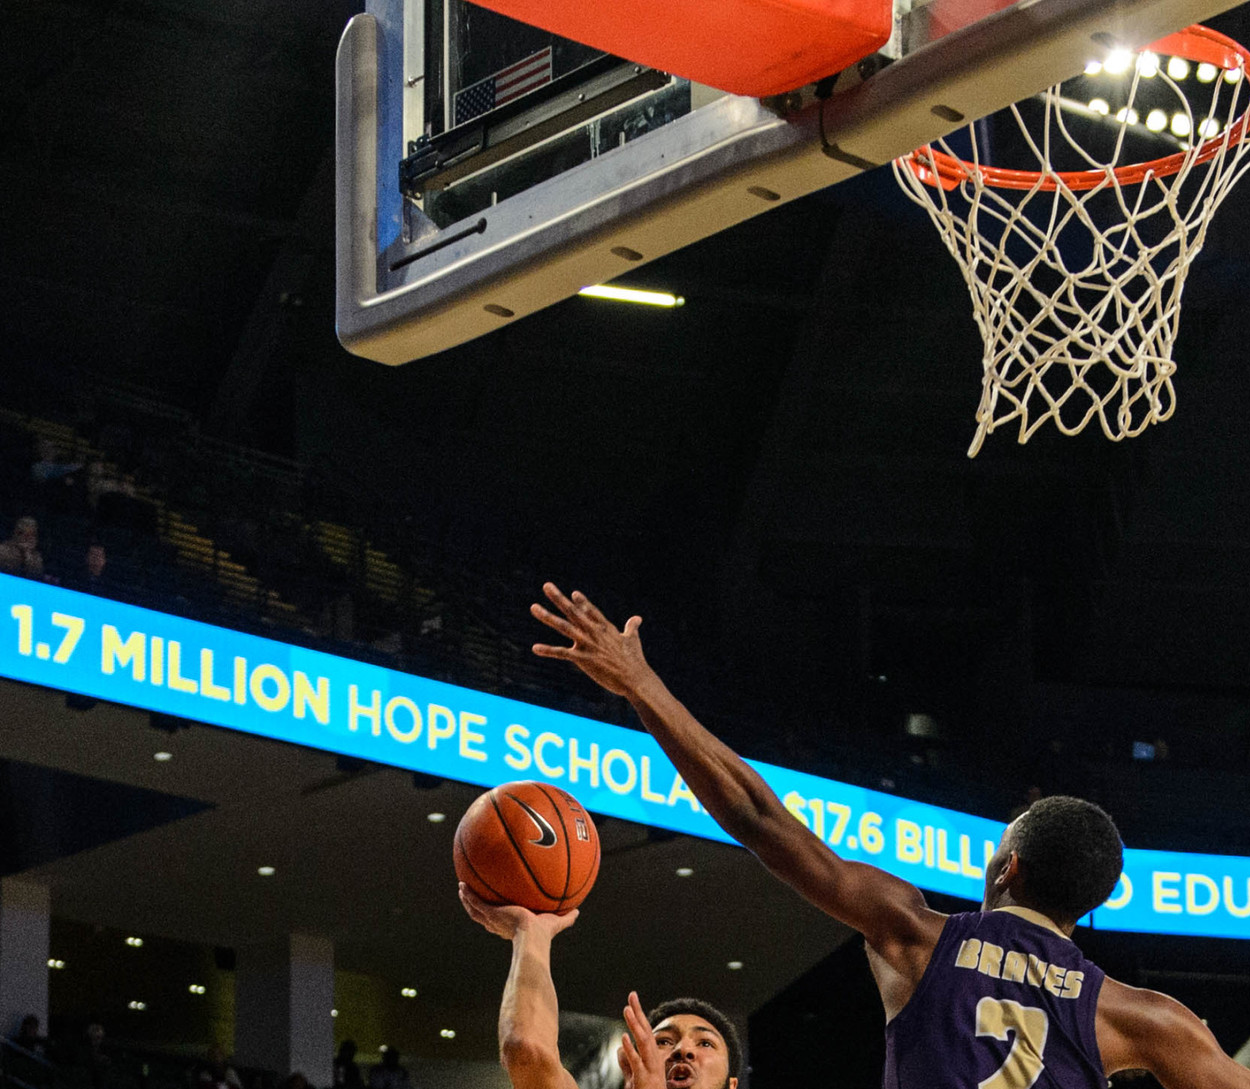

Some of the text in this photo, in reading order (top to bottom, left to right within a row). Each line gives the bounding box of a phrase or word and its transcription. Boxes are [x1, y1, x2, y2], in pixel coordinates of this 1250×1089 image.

[11, 604, 85, 664] 1.7
[101, 624, 330, 725] MILLION
[349, 684, 488, 762] HOPE
[505, 724, 709, 816] SCHOLA
[955, 938, 1084, 999] BRAVES
